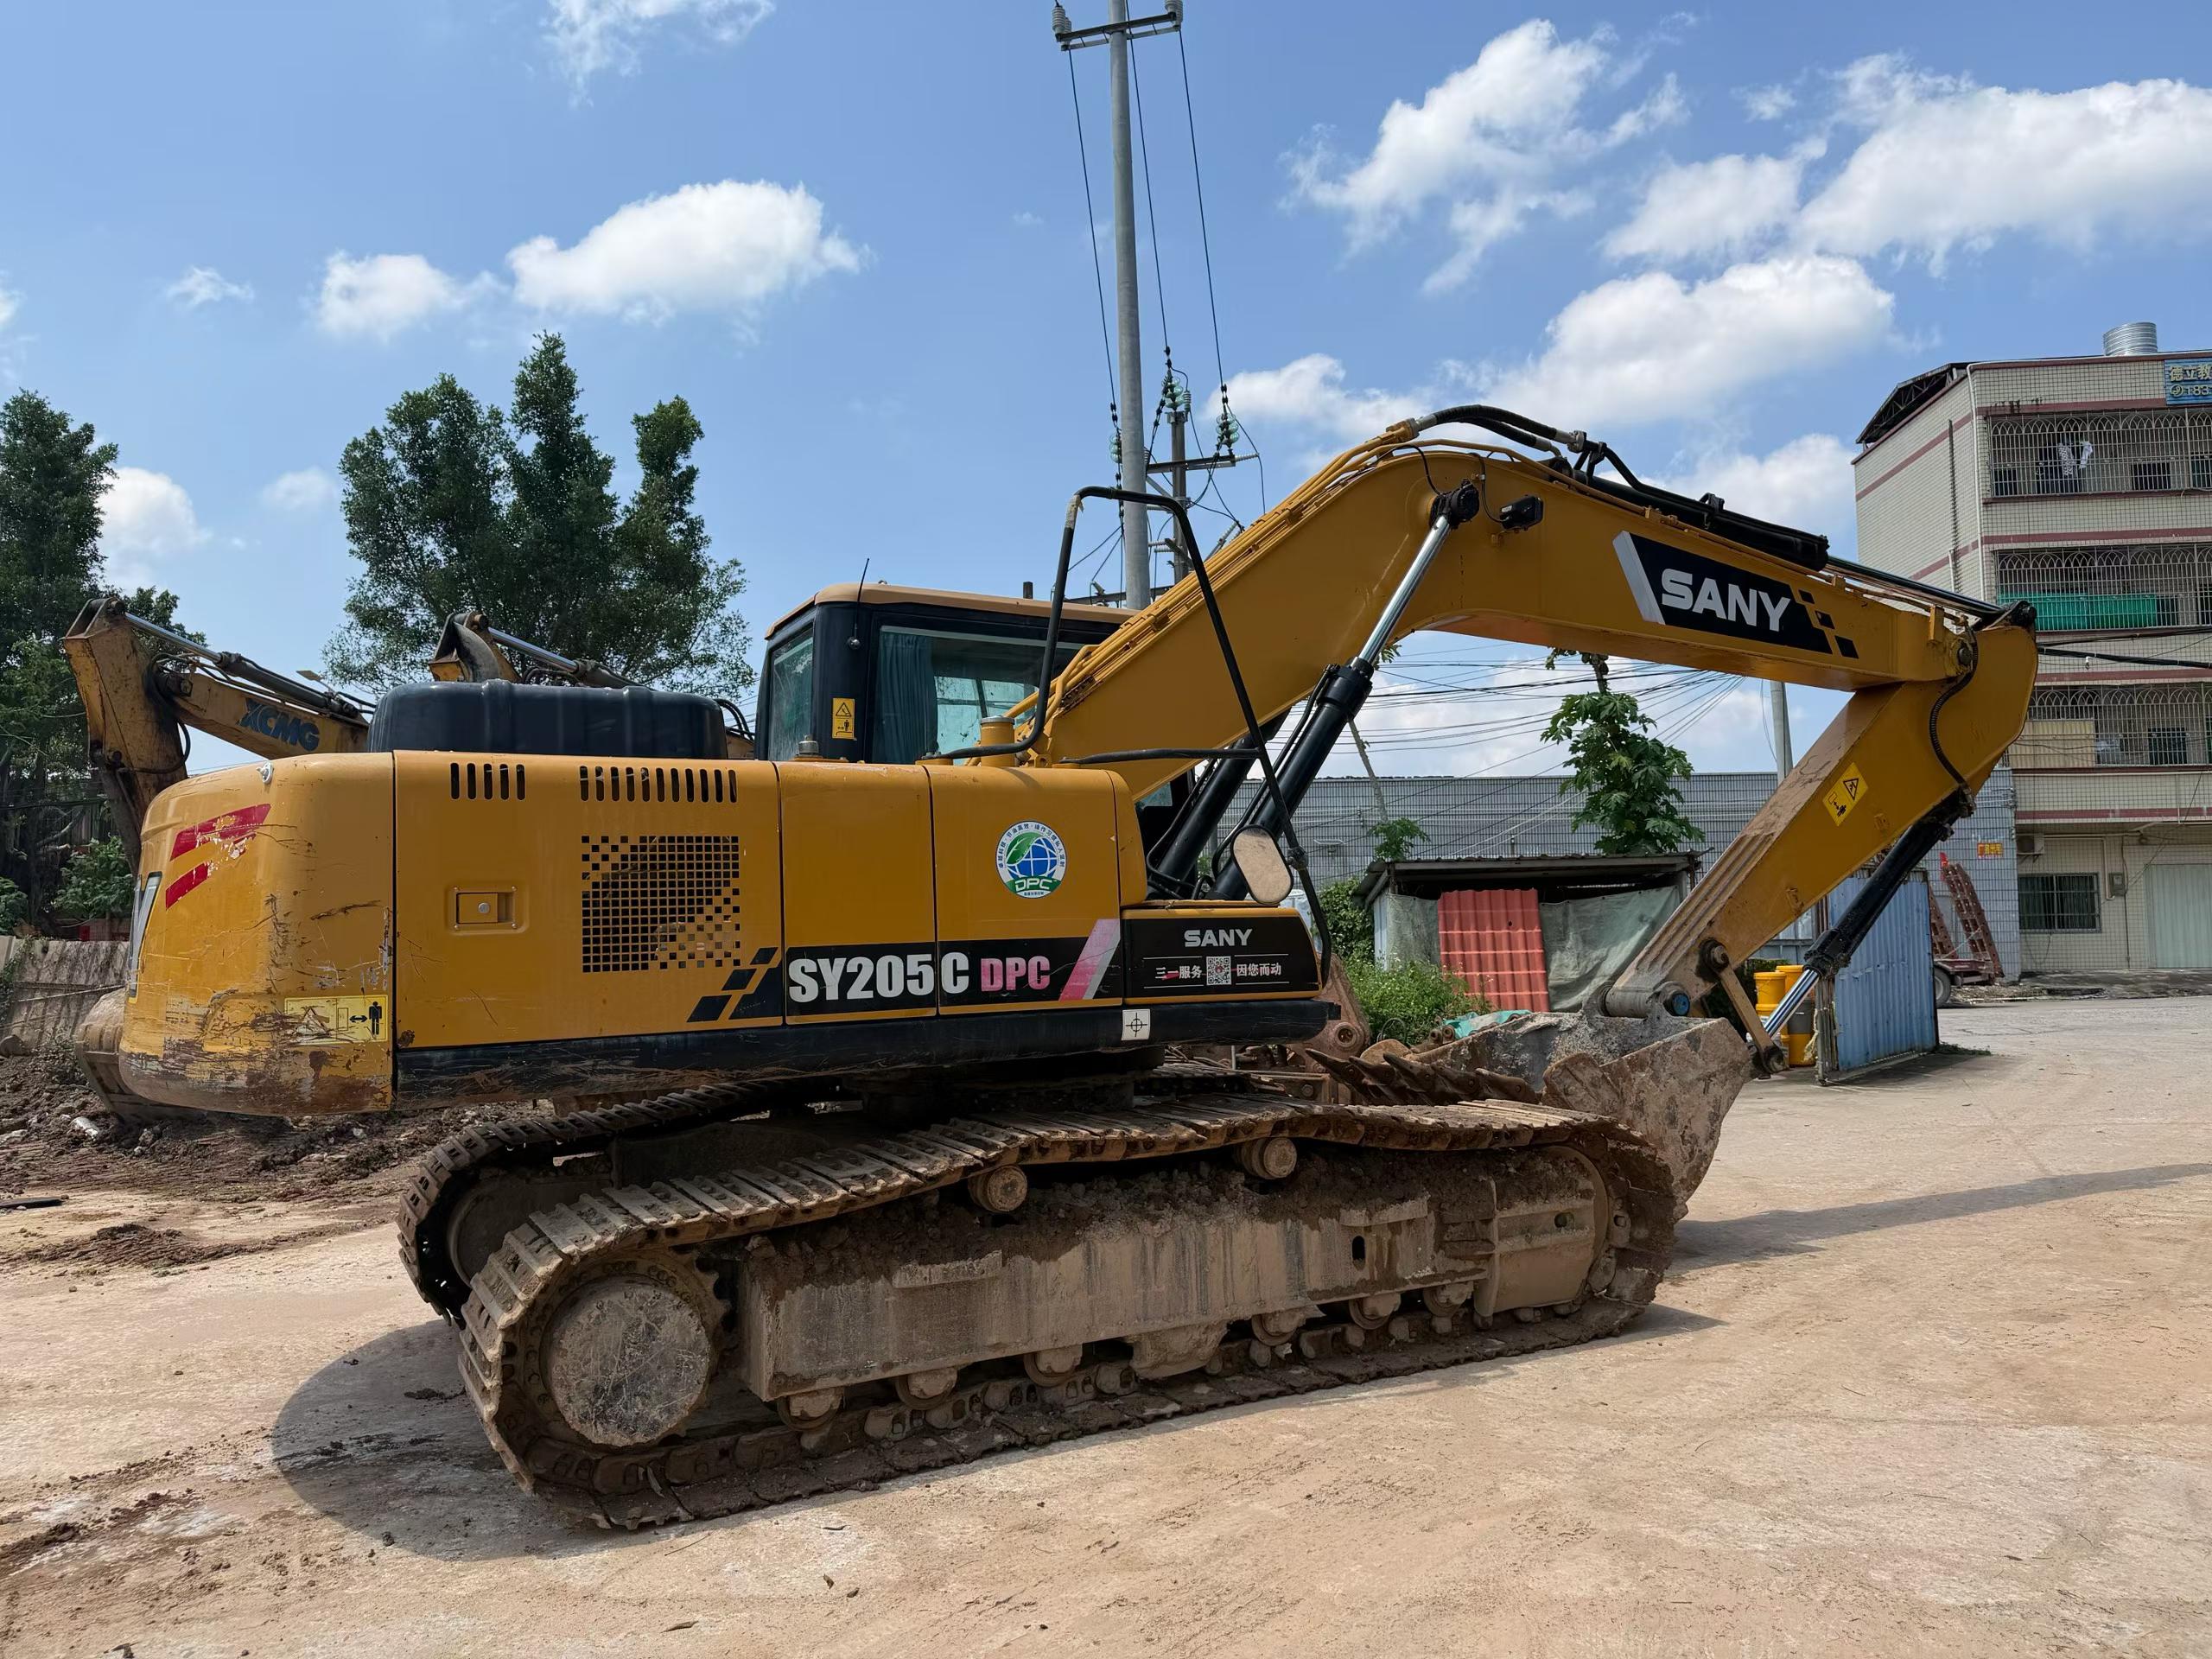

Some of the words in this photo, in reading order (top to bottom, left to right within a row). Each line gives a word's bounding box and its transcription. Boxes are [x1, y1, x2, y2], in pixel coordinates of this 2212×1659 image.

[1661, 568, 1791, 632] SANY
[238, 698, 320, 751] XCMG
[1014, 877, 1052, 892] DPC
[1184, 928, 1253, 947] SANY
[788, 951, 969, 1002] SY205C
[981, 956, 1051, 992] DPC
[1155, 965, 1203, 979] 三一服务
[1236, 962, 1281, 977] 因您而动
